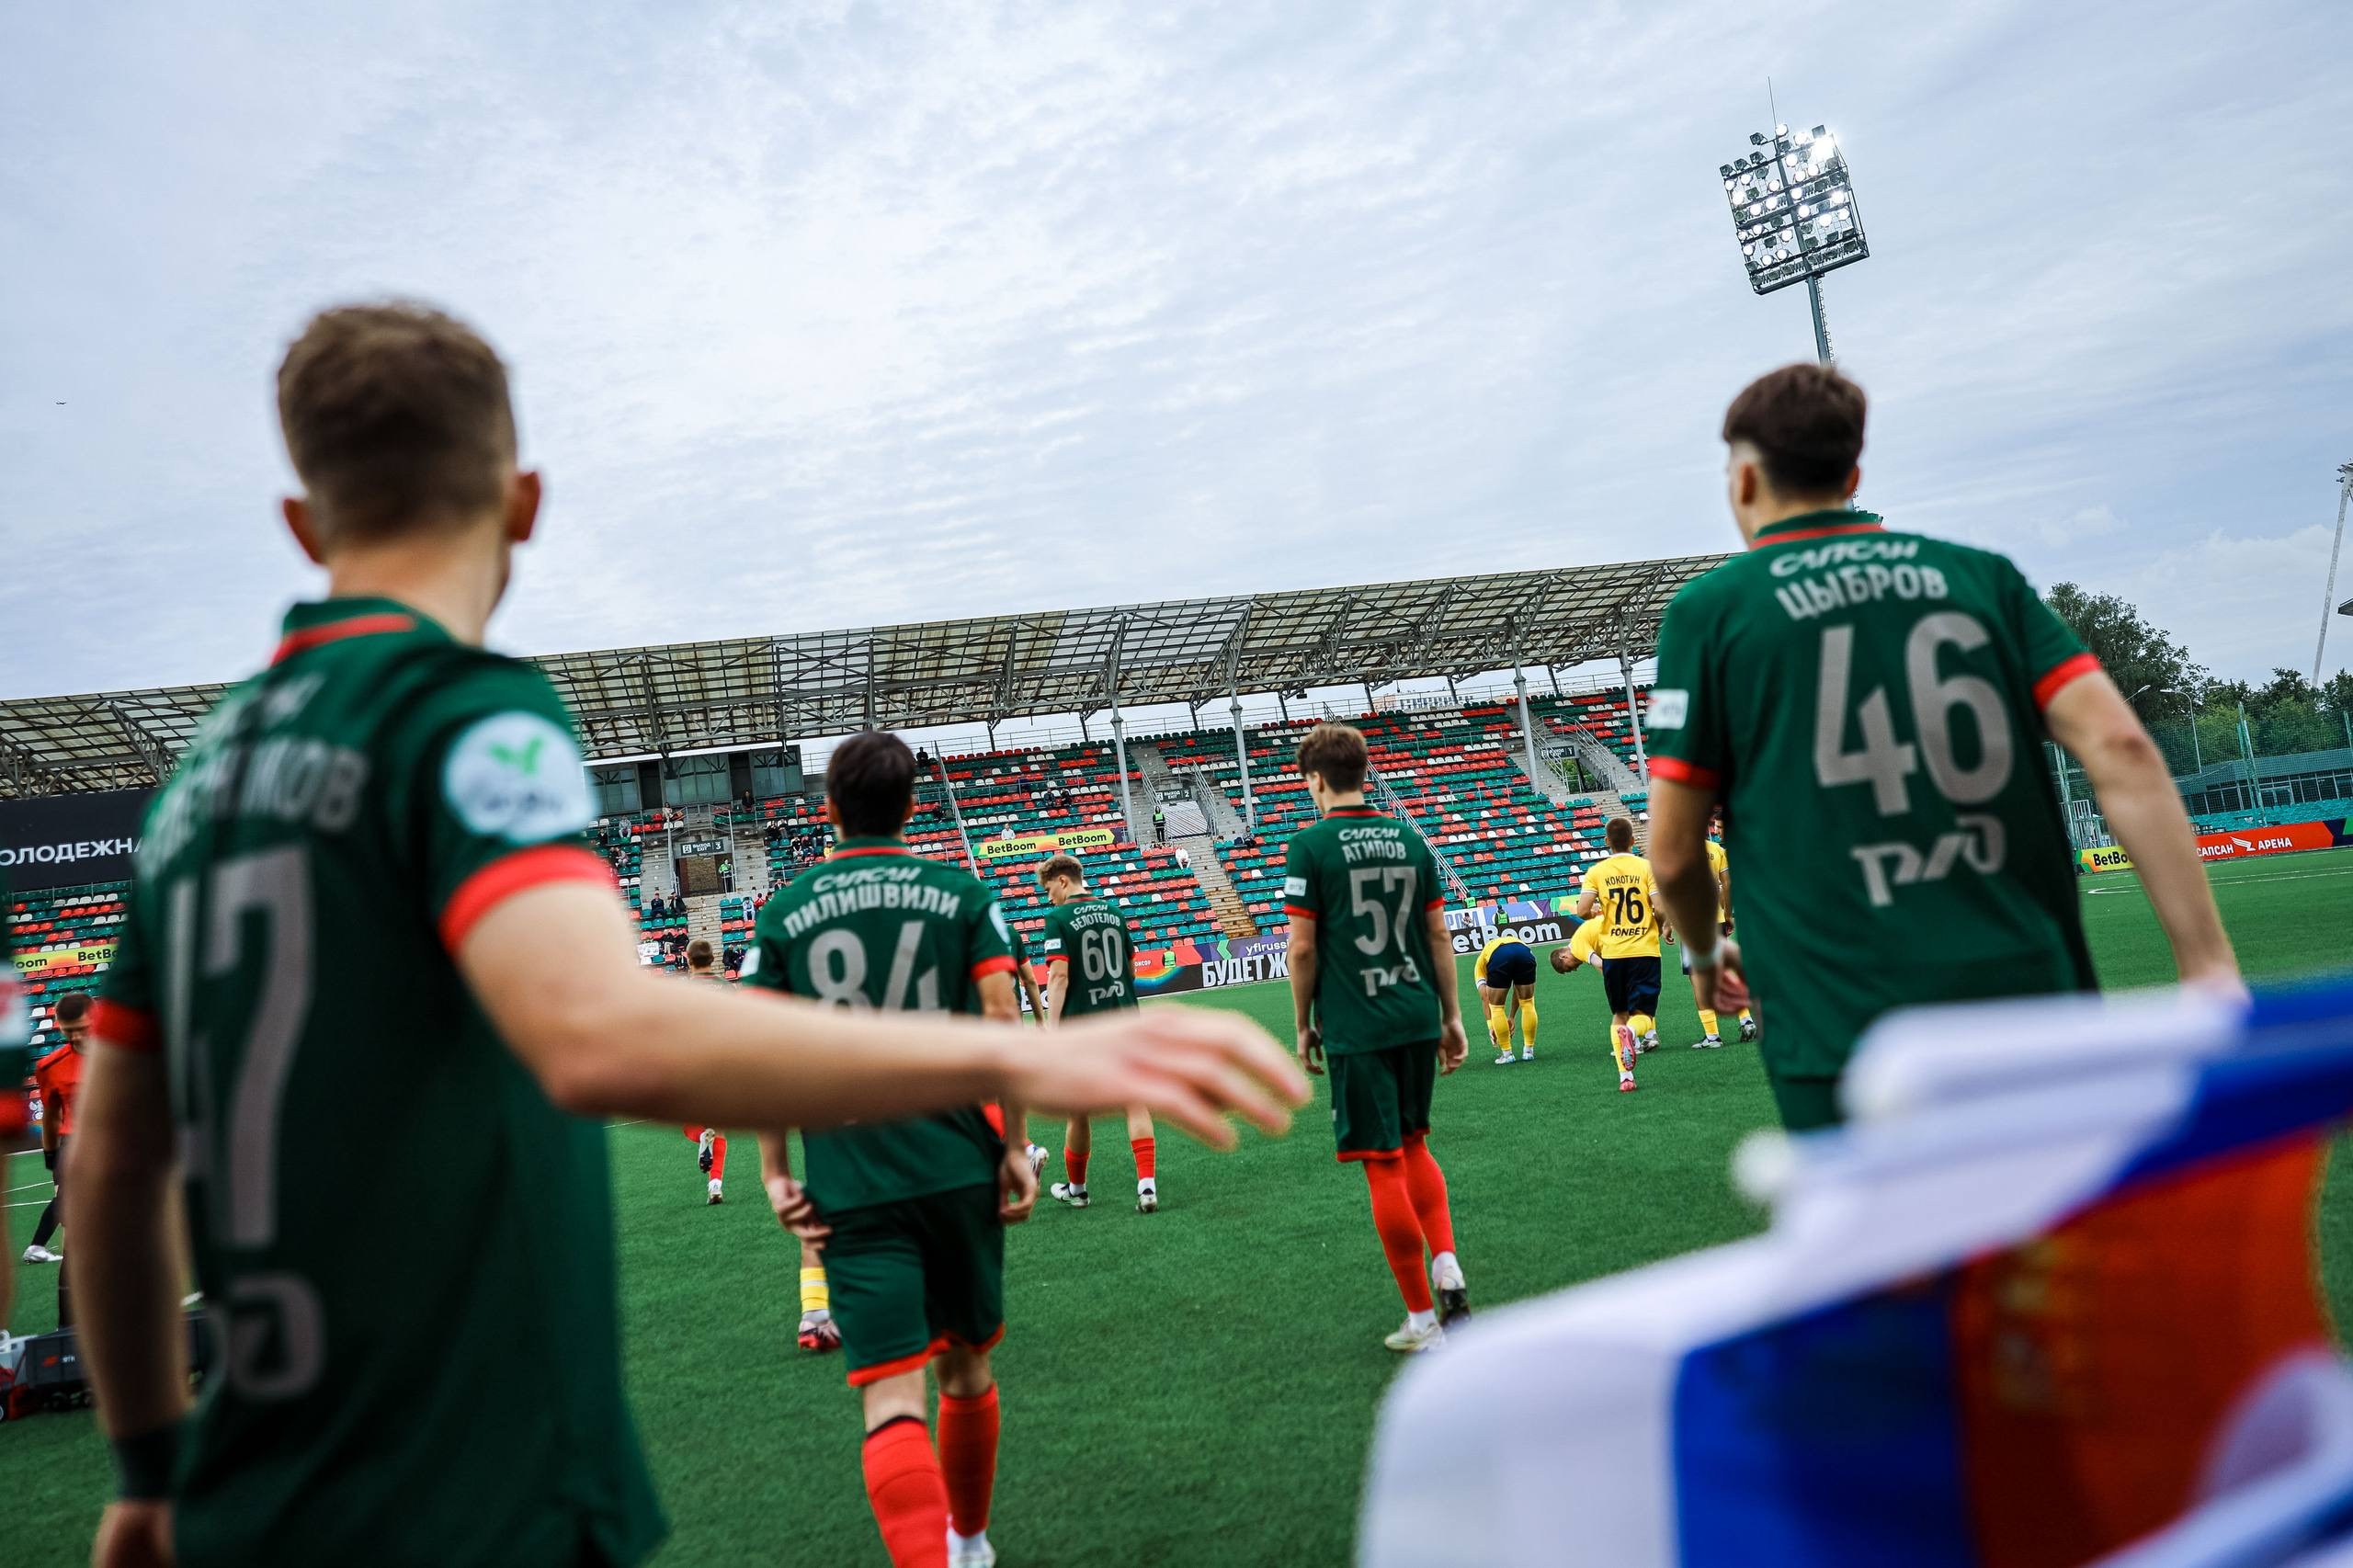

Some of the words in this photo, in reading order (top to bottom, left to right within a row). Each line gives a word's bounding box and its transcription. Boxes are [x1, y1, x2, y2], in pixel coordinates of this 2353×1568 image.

[1775, 562, 1949, 621] ЦЫБРОВ
[1813, 609, 2014, 816] 46
[986, 841, 1036, 855] BetBoom
[1058, 833, 1107, 846] BetBoom
[1338, 827, 1400, 842] САПСАН
[2197, 844, 2234, 857] САПСАН
[2257, 837, 2293, 851] АРЕНА
[0, 837, 142, 867] ОЛОДЕЖН
[1342, 839, 1407, 863] АТИПОВ
[2093, 851, 2128, 867] BetBo
[1605, 875, 1640, 887] КОКОТУН
[783, 882, 961, 938] ПИЛИШВИЛИ
[1350, 867, 1416, 956] 57
[1608, 886, 1644, 926] 76
[1070, 913, 1121, 931] БЕЛОТЕЛОВ
[1610, 926, 1647, 937] FONBET
[809, 920, 952, 1014] 84
[1081, 927, 1123, 982] 60
[1202, 954, 1264, 988] БУДЕТ
[1267, 951, 1290, 979] Ж
